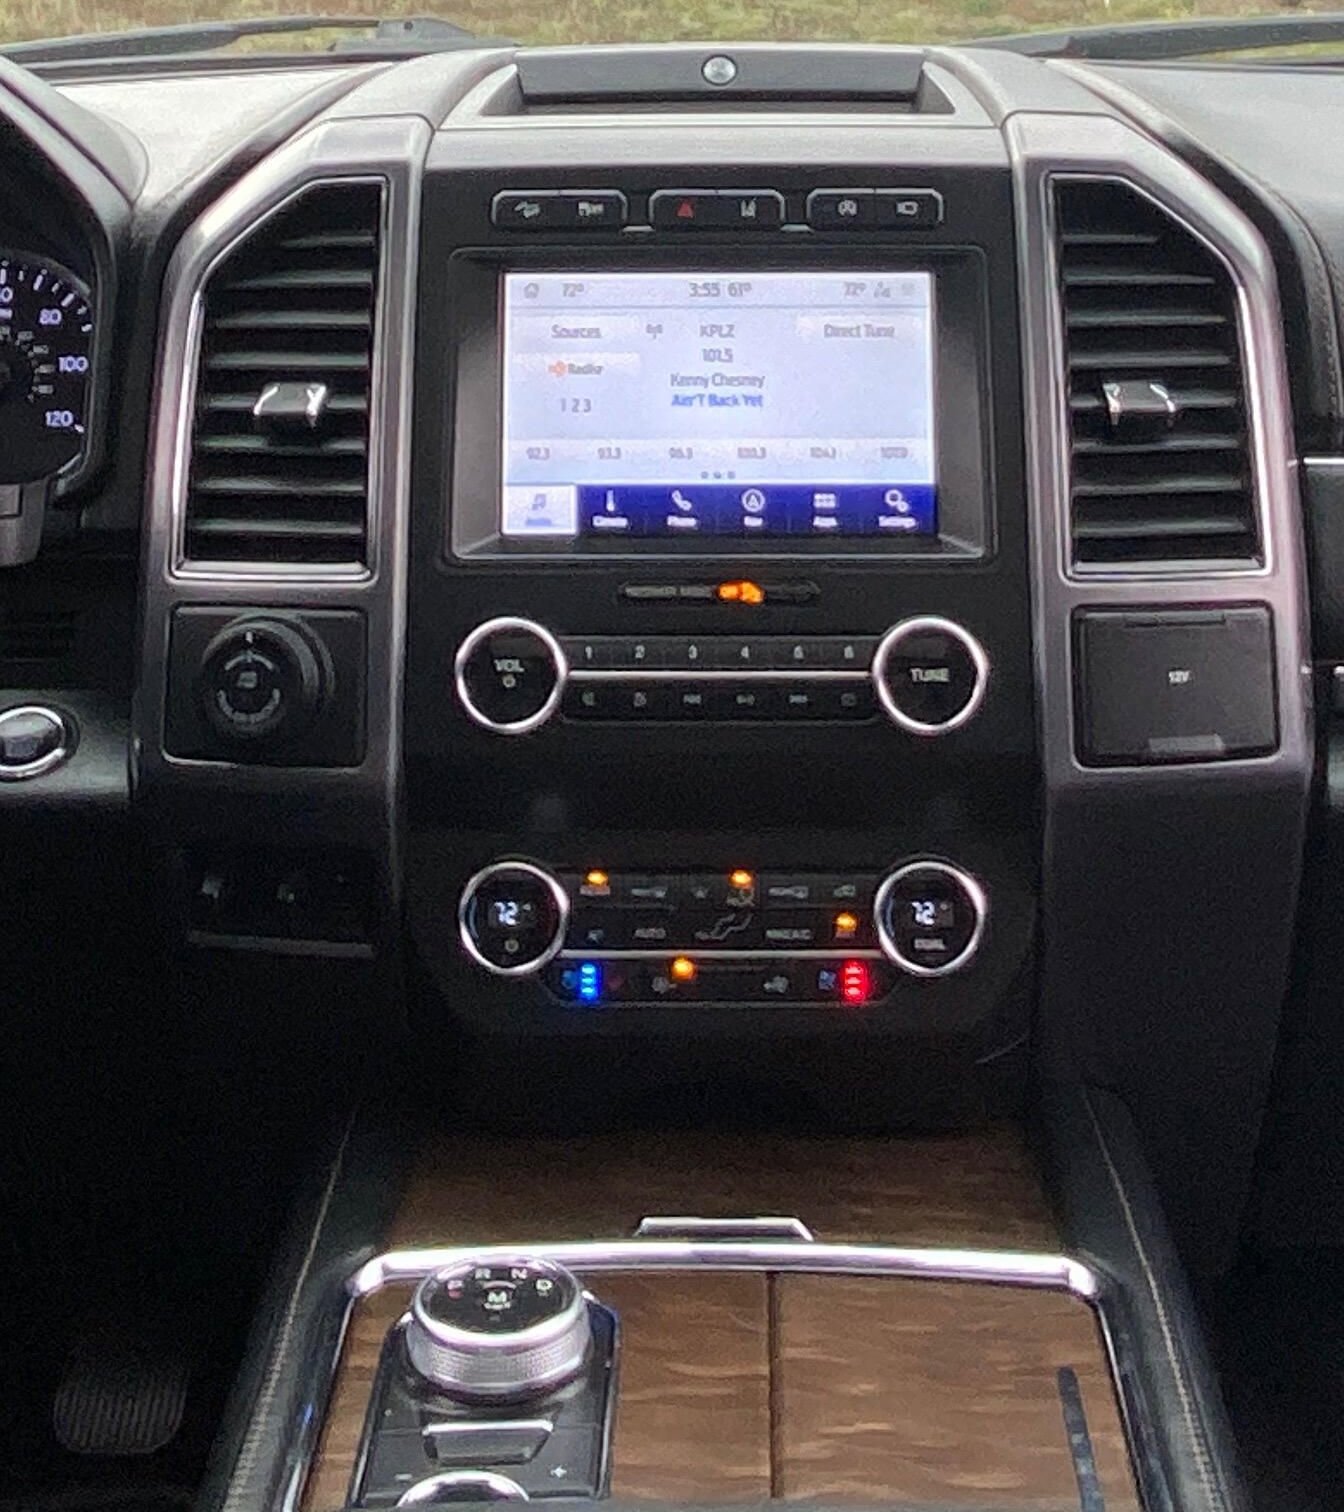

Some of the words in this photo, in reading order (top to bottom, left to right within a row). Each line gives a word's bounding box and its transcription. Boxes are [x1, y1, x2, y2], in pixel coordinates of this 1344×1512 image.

[39, 309, 62, 325] 80
[551, 324, 602, 339] Sources
[700, 324, 735, 338] KPLZ
[823, 324, 861, 338] Direct
[864, 324, 895, 338] Tune
[58, 356, 88, 372] 100
[670, 373, 709, 388] Kenny
[711, 373, 765, 388] Chesney
[571, 398, 581, 412] 2
[583, 398, 592, 413] 3
[708, 394, 738, 406] Back
[742, 394, 763, 407] Yet
[45, 411, 74, 427] 120
[585, 645, 593, 659] 1
[635, 644, 645, 659] 2
[688, 645, 698, 659] 3
[740, 645, 750, 659] 4
[493, 659, 524, 672] VOL
